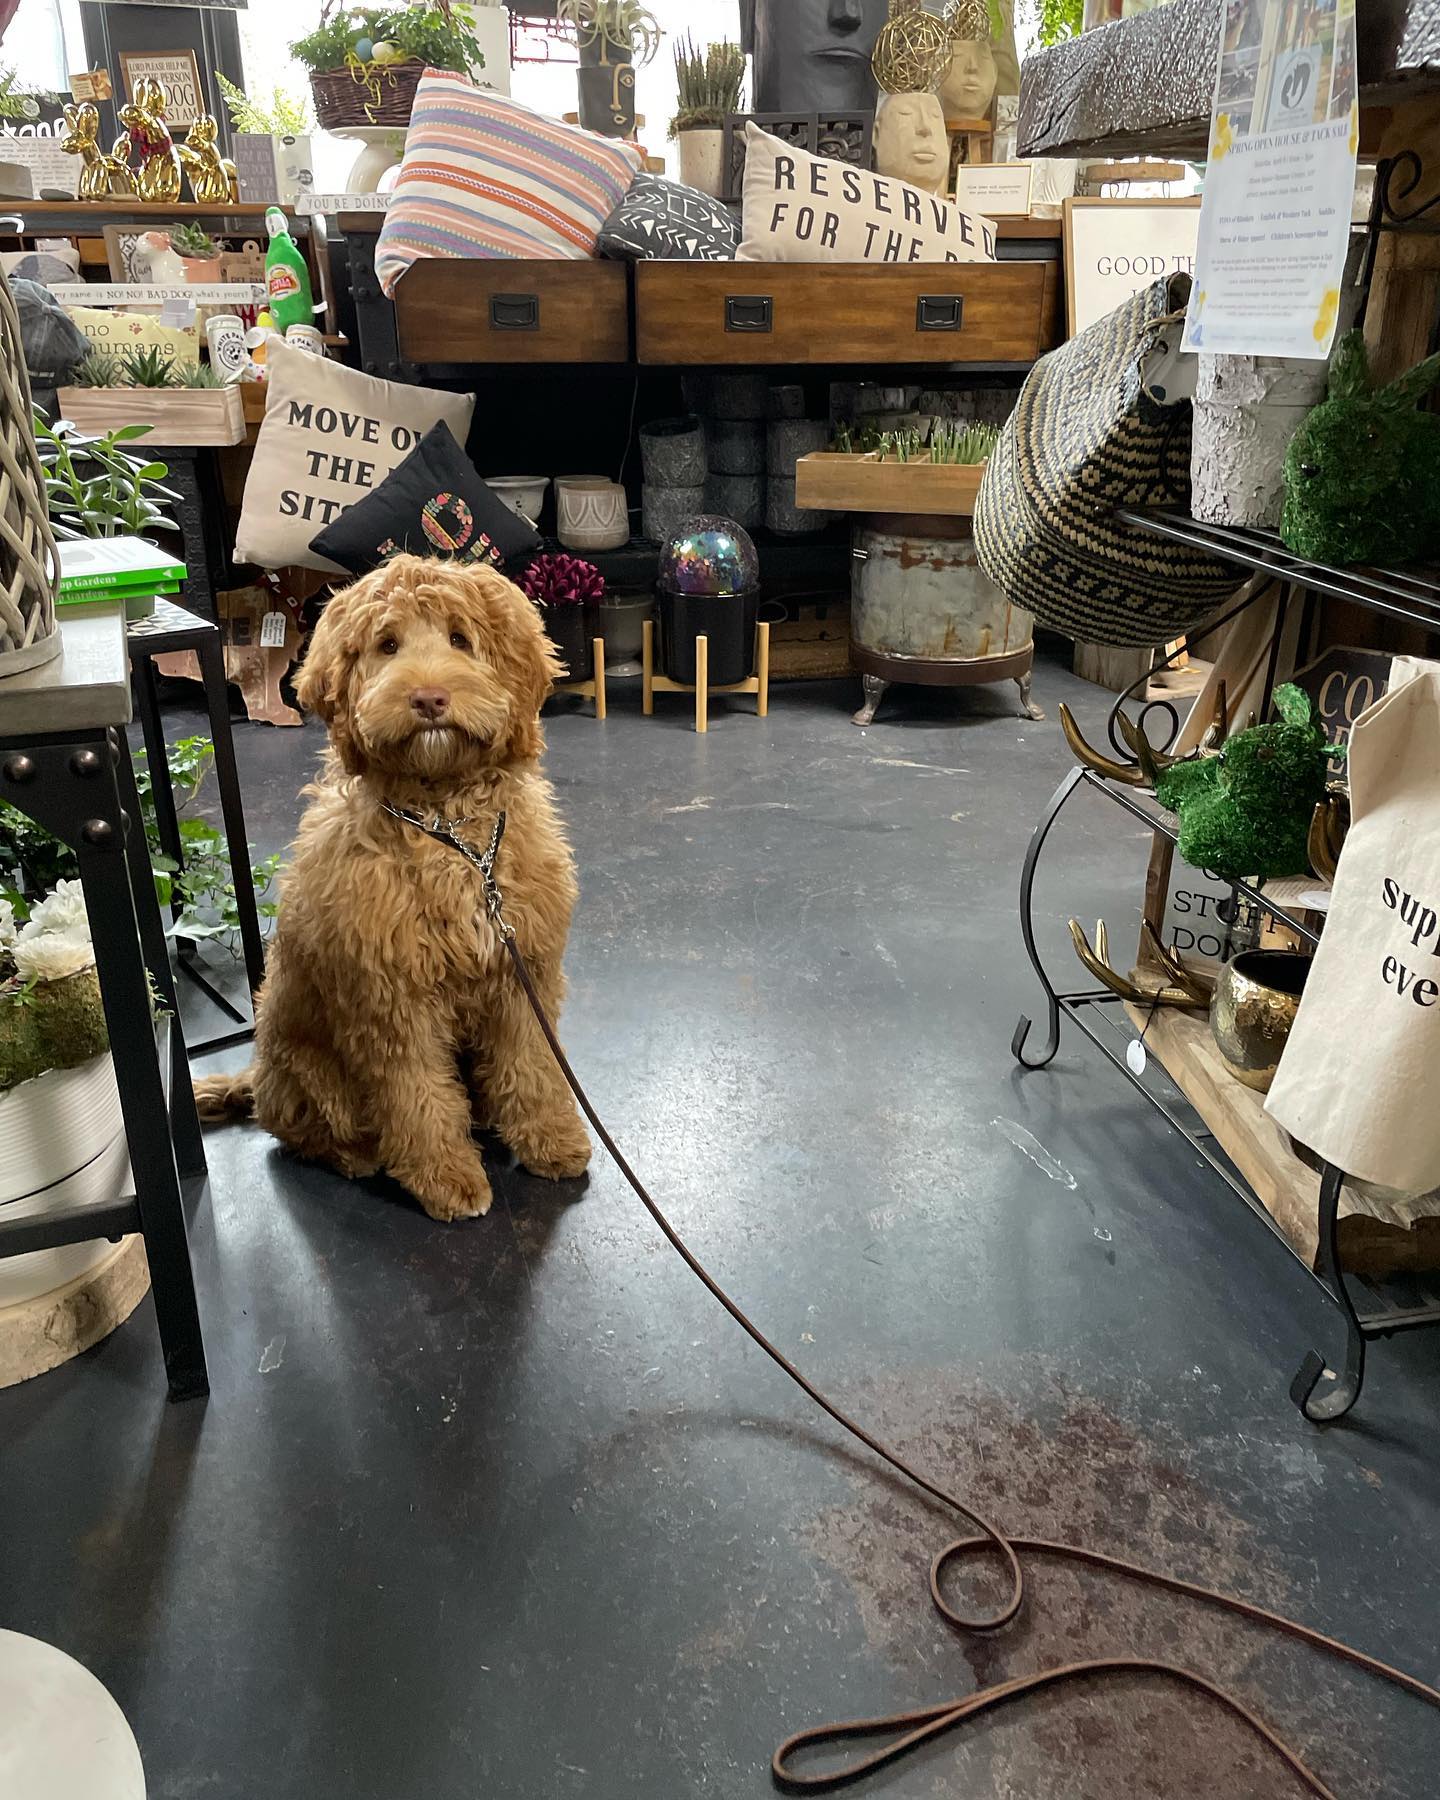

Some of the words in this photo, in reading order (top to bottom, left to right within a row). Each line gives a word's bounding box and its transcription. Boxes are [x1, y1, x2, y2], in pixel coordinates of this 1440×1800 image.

[129, 62, 145, 72] LORD
[145, 62, 165, 71] PLEASE
[166, 62, 179, 70] HELP
[180, 61, 189, 70] ME
[160, 72, 191, 83] PERSON
[164, 84, 195, 107] DOG
[1228, 140, 1254, 156] SPRING
[1254, 136, 1273, 151] OPEN
[1274, 133, 1300, 148] HOUSE
[1302, 132, 1309, 144] &
[1310, 128, 1332, 143] TACK
[774, 156, 994, 260] RESERVED
[770, 203, 840, 249] FOR
[864, 221, 924, 262] THE
[1097, 256, 1165, 276] GOOD
[96, 290, 103, 298] is
[106, 290, 123, 299] NO!
[126, 290, 143, 299] NO!
[148, 290, 168, 299] BAD
[170, 290, 193, 299] DOG!
[197, 290, 220, 298] what's
[224, 290, 248, 300] yours?
[85, 324, 109, 336] no
[288, 401, 380, 444] MOVE
[306, 450, 375, 488] THE
[74, 576, 117, 588] Gardens
[65, 590, 108, 602] Gardens
[1319, 670, 1388, 722] CO
